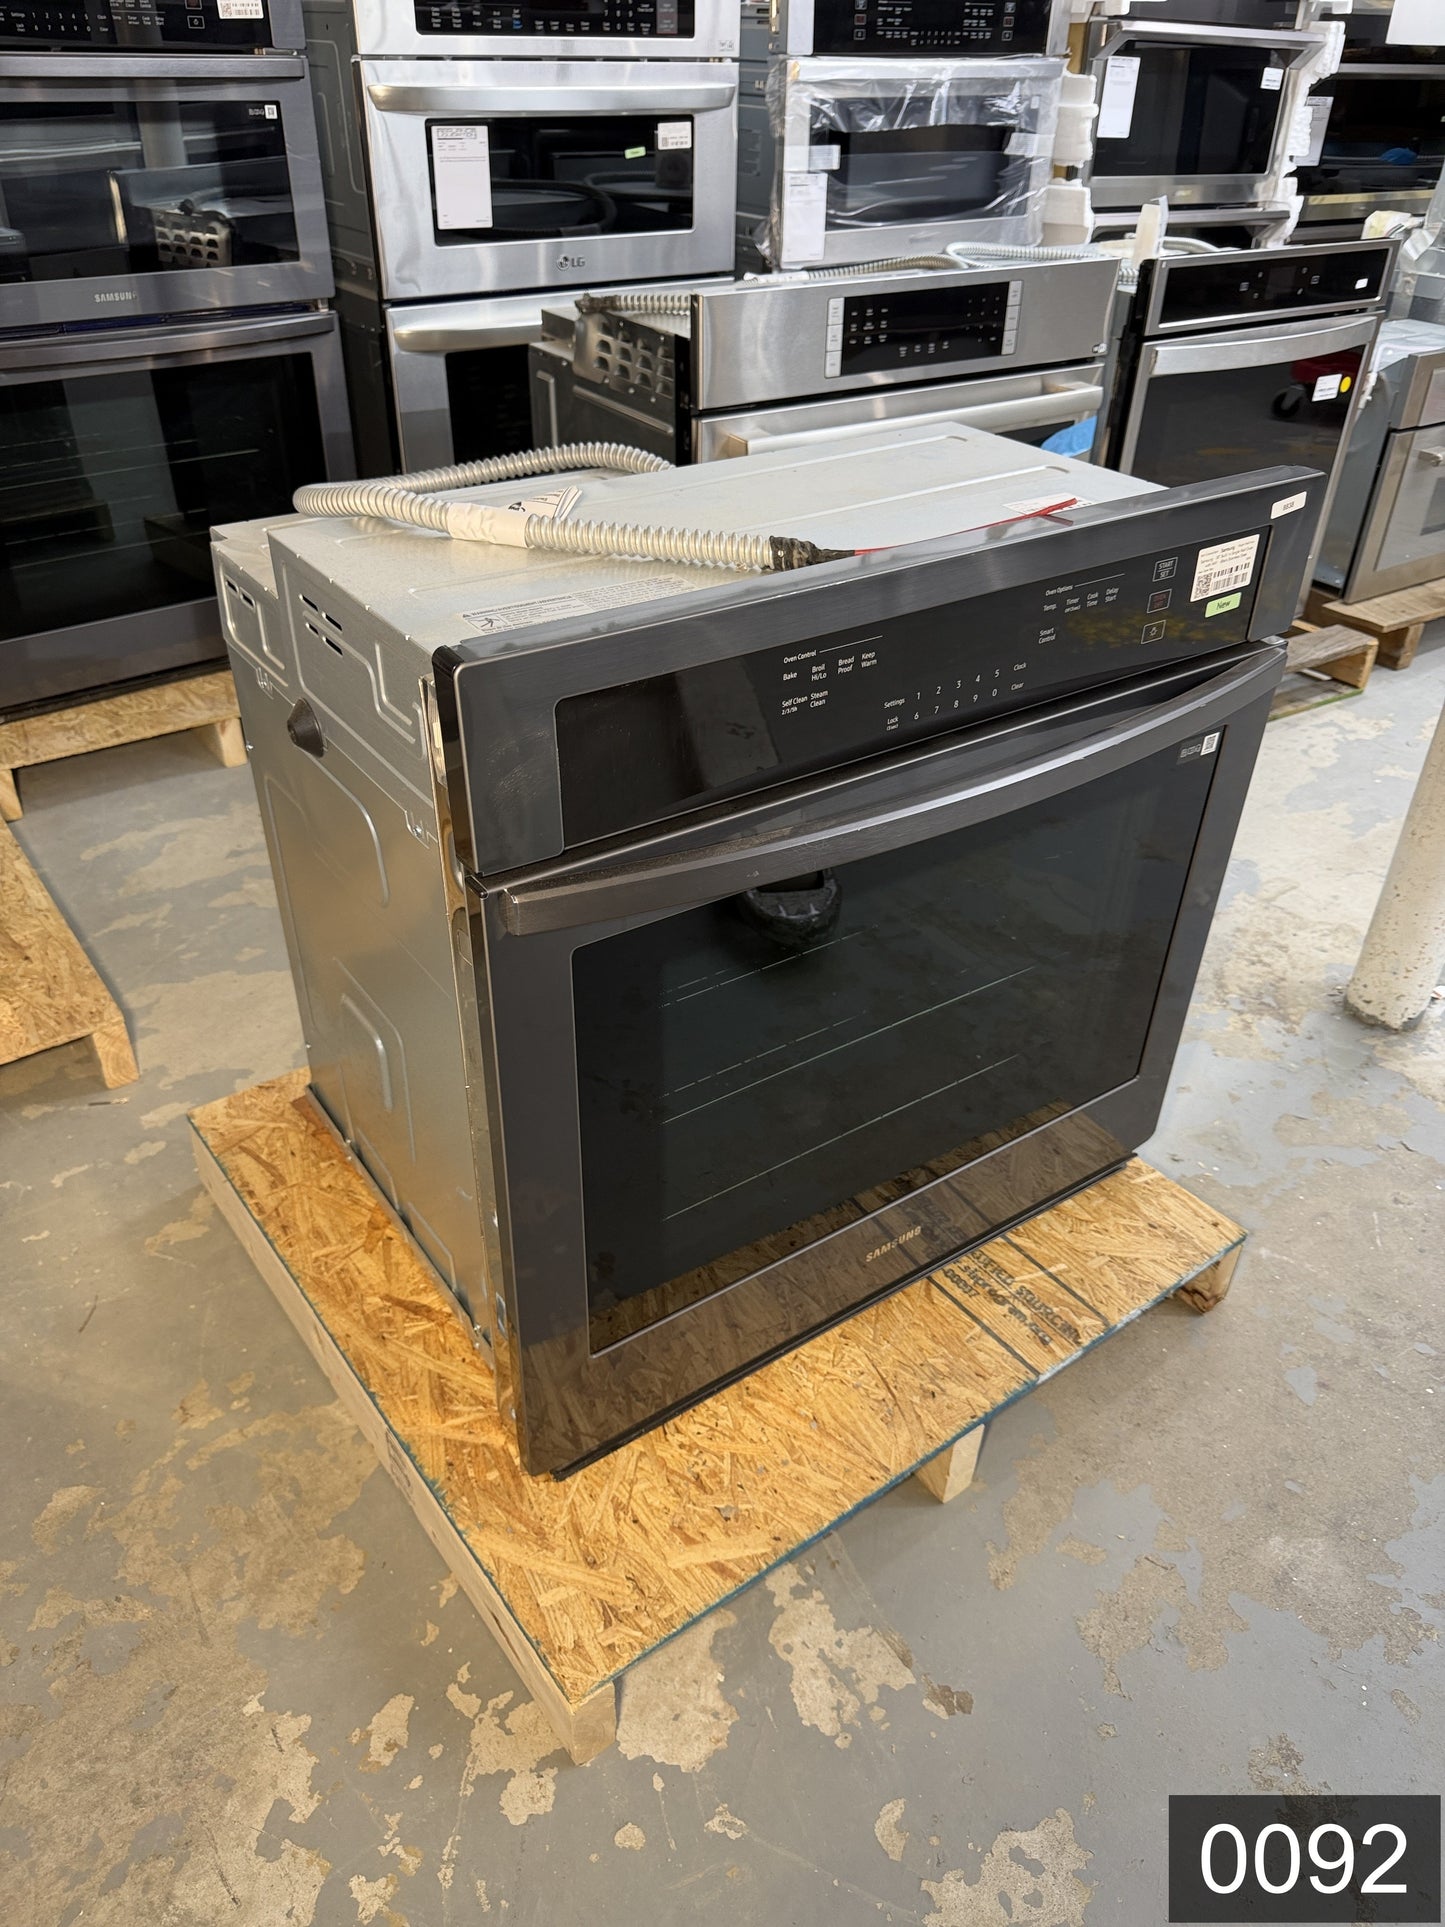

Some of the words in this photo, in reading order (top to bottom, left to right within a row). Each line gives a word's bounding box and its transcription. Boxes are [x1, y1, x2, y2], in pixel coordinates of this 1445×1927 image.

[571, 256, 586, 268] LG
[1158, 560, 1174, 570] START
[1045, 589, 1057, 597] Oven
[1056, 585, 1074, 594] Options
[1216, 600, 1231, 611] New
[1039, 627, 1054, 637] Smart
[1038, 633, 1056, 645] Control
[783, 655, 797, 664] Oven
[797, 650, 817, 660] Control
[861, 651, 876, 660] Keep
[838, 656, 855, 666] Bread
[861, 659, 878, 668] Warm
[811, 664, 826, 673] Broil
[838, 664, 853, 675] Proof
[1013, 662, 1027, 671] Clock
[782, 671, 798, 681] Bake
[811, 672, 827, 682] Hi/Lo
[884, 698, 906, 709] Settings
[936, 686, 942, 695] 2
[956, 680, 962, 689] 3
[975, 674, 981, 683] 4
[994, 669, 1000, 678] 5
[810, 690, 829, 700] Steam
[782, 699, 793, 708] Self
[793, 696, 808, 705] Clean
[809, 699, 826, 708] Clean
[913, 711, 920, 720] 6
[934, 706, 940, 714] 7
[953, 700, 960, 708] 8
[972, 694, 979, 703] 9
[991, 688, 998, 697] 0
[887, 716, 899, 725] Lock
[865, 1225, 922, 1263] SAMSUNG
